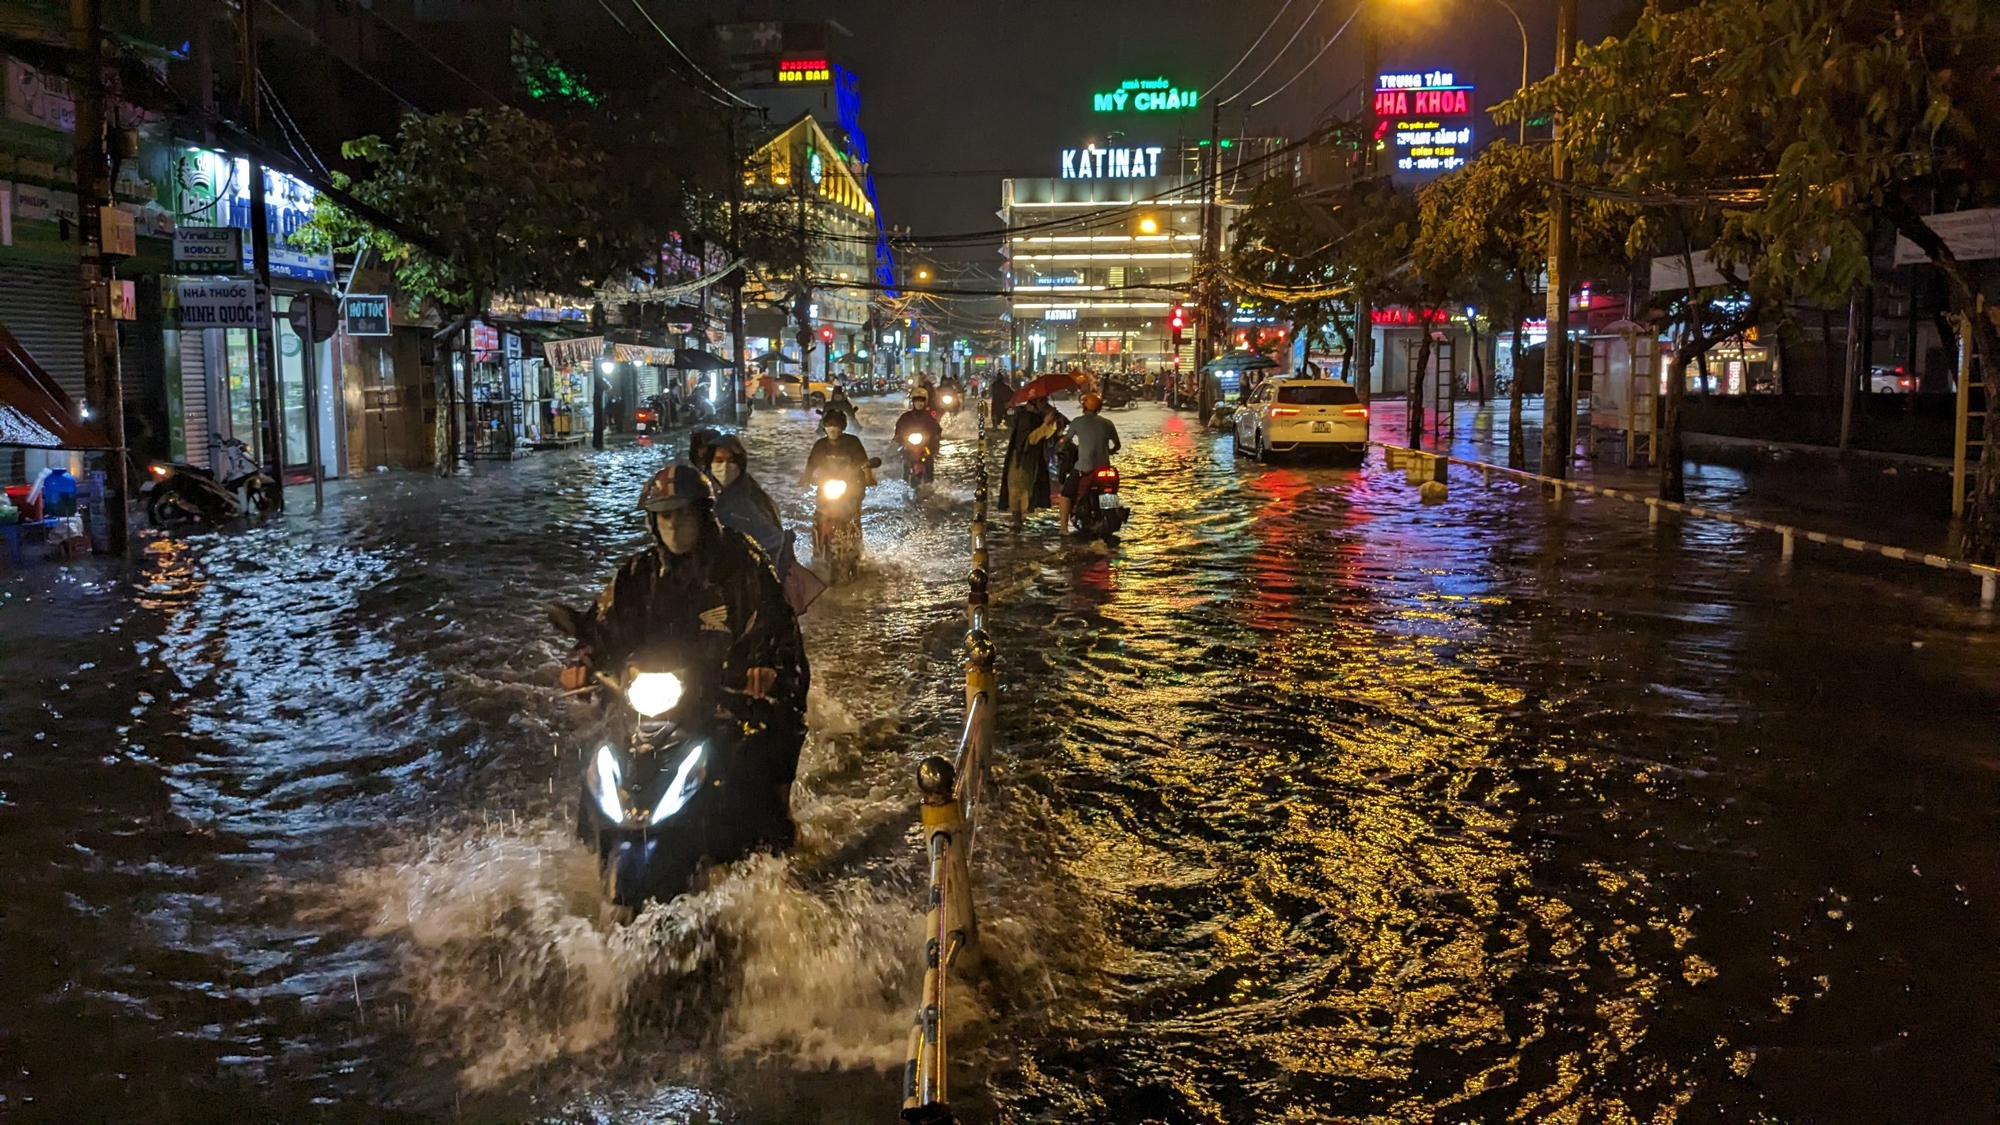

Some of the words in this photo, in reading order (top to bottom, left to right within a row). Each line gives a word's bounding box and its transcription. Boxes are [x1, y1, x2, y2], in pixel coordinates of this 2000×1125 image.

[779, 71, 803, 81] HOA
[805, 70, 829, 80] BAN
[1380, 74, 1422, 88] TRUNG
[1425, 71, 1453, 86] TÂM
[1094, 89, 1128, 111] MỸ
[1135, 88, 1197, 110] CHÂU
[1415, 91, 1467, 114] KHOA
[1062, 147, 1162, 179] KATINAT
[183, 285, 207, 298] NHÀ
[210, 284, 247, 298] THUỐC
[180, 305, 215, 323] MINH
[219, 300, 254, 323] QUỐC
[1045, 309, 1078, 321] KATINAT
[1371, 310, 1403, 324] NHA
